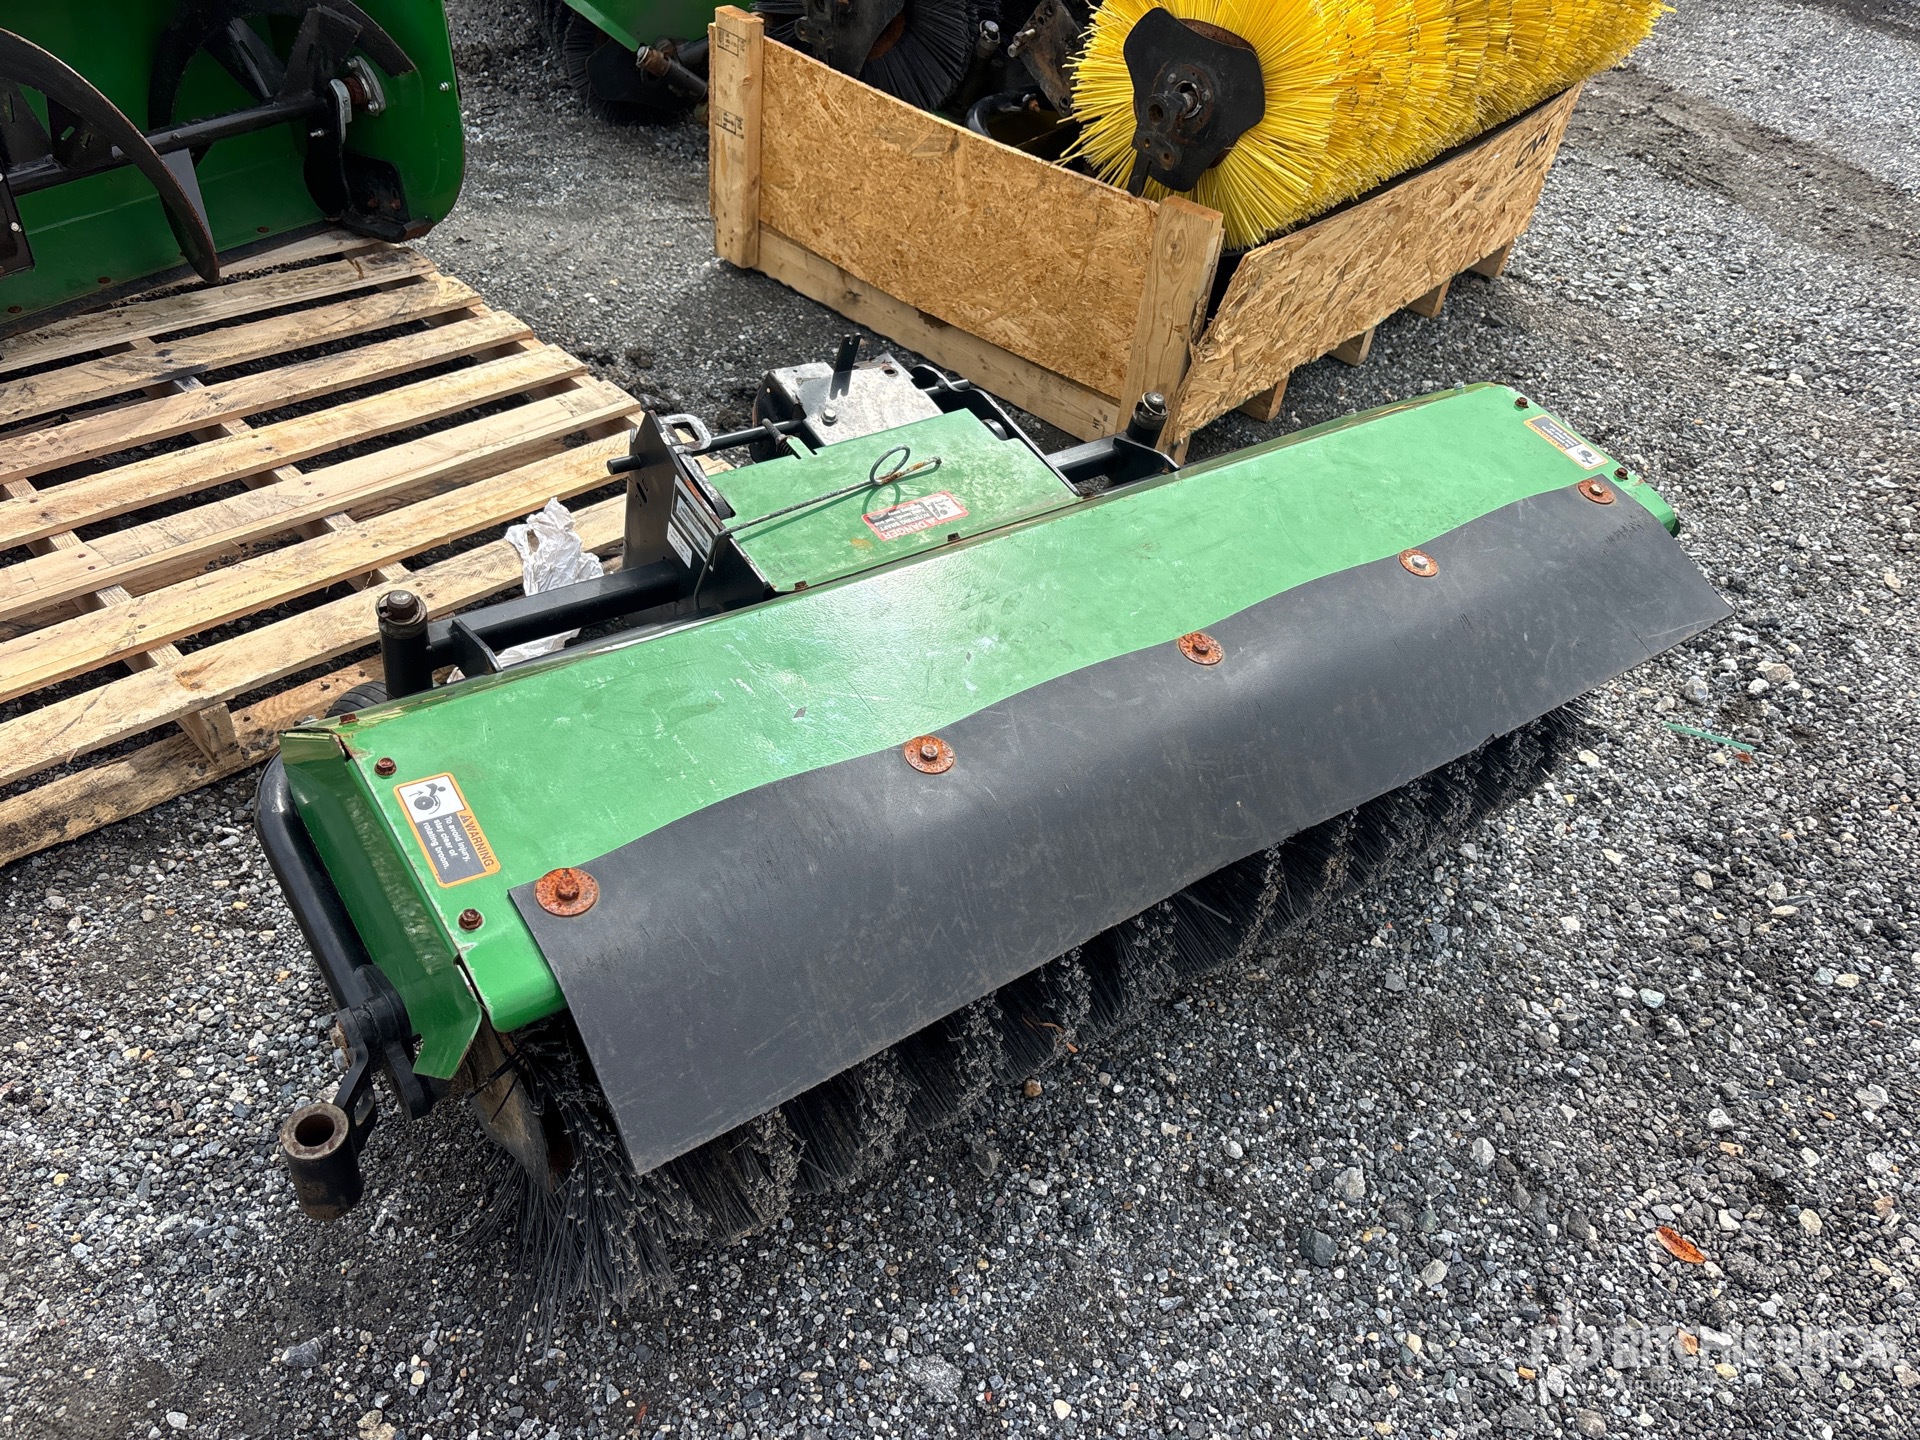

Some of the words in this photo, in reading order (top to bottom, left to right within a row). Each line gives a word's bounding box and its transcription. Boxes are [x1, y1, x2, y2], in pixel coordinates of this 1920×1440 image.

[881, 521, 927, 539] DANGER
[423, 822, 439, 847] rotating
[435, 846, 450, 870] broom.
[434, 819, 445, 832] stay
[441, 832, 453, 851] clear
[448, 849, 458, 857] of
[444, 815, 453, 824] To
[449, 824, 463, 842] avoid
[466, 821, 494, 867] WARNING
